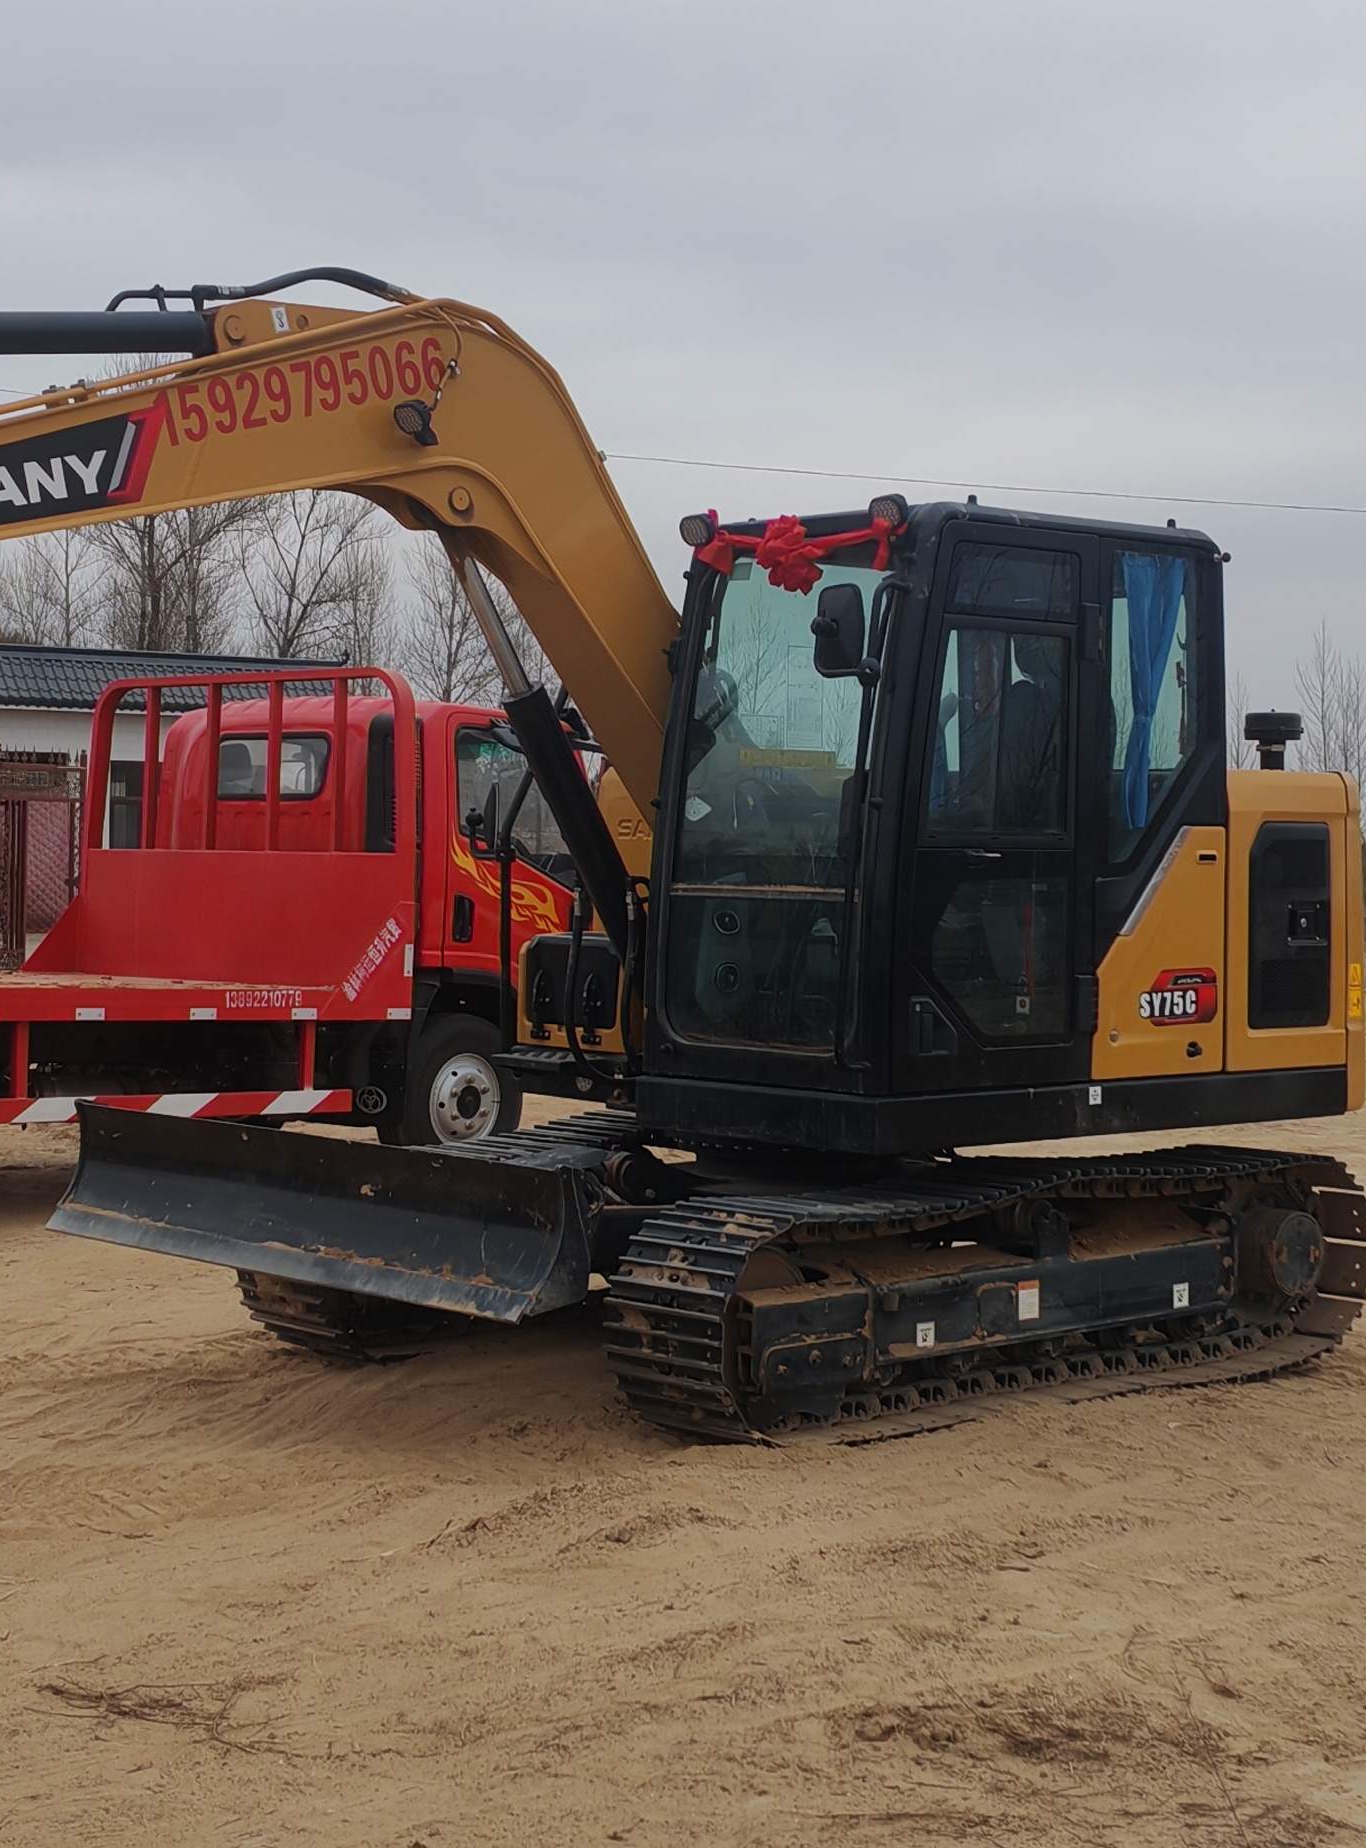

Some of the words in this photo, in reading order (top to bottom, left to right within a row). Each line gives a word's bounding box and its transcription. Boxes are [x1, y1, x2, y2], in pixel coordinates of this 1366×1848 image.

[154, 336, 443, 447] 15929795066
[617, 819, 653, 841] SA
[1139, 989, 1197, 1019] SY75C
